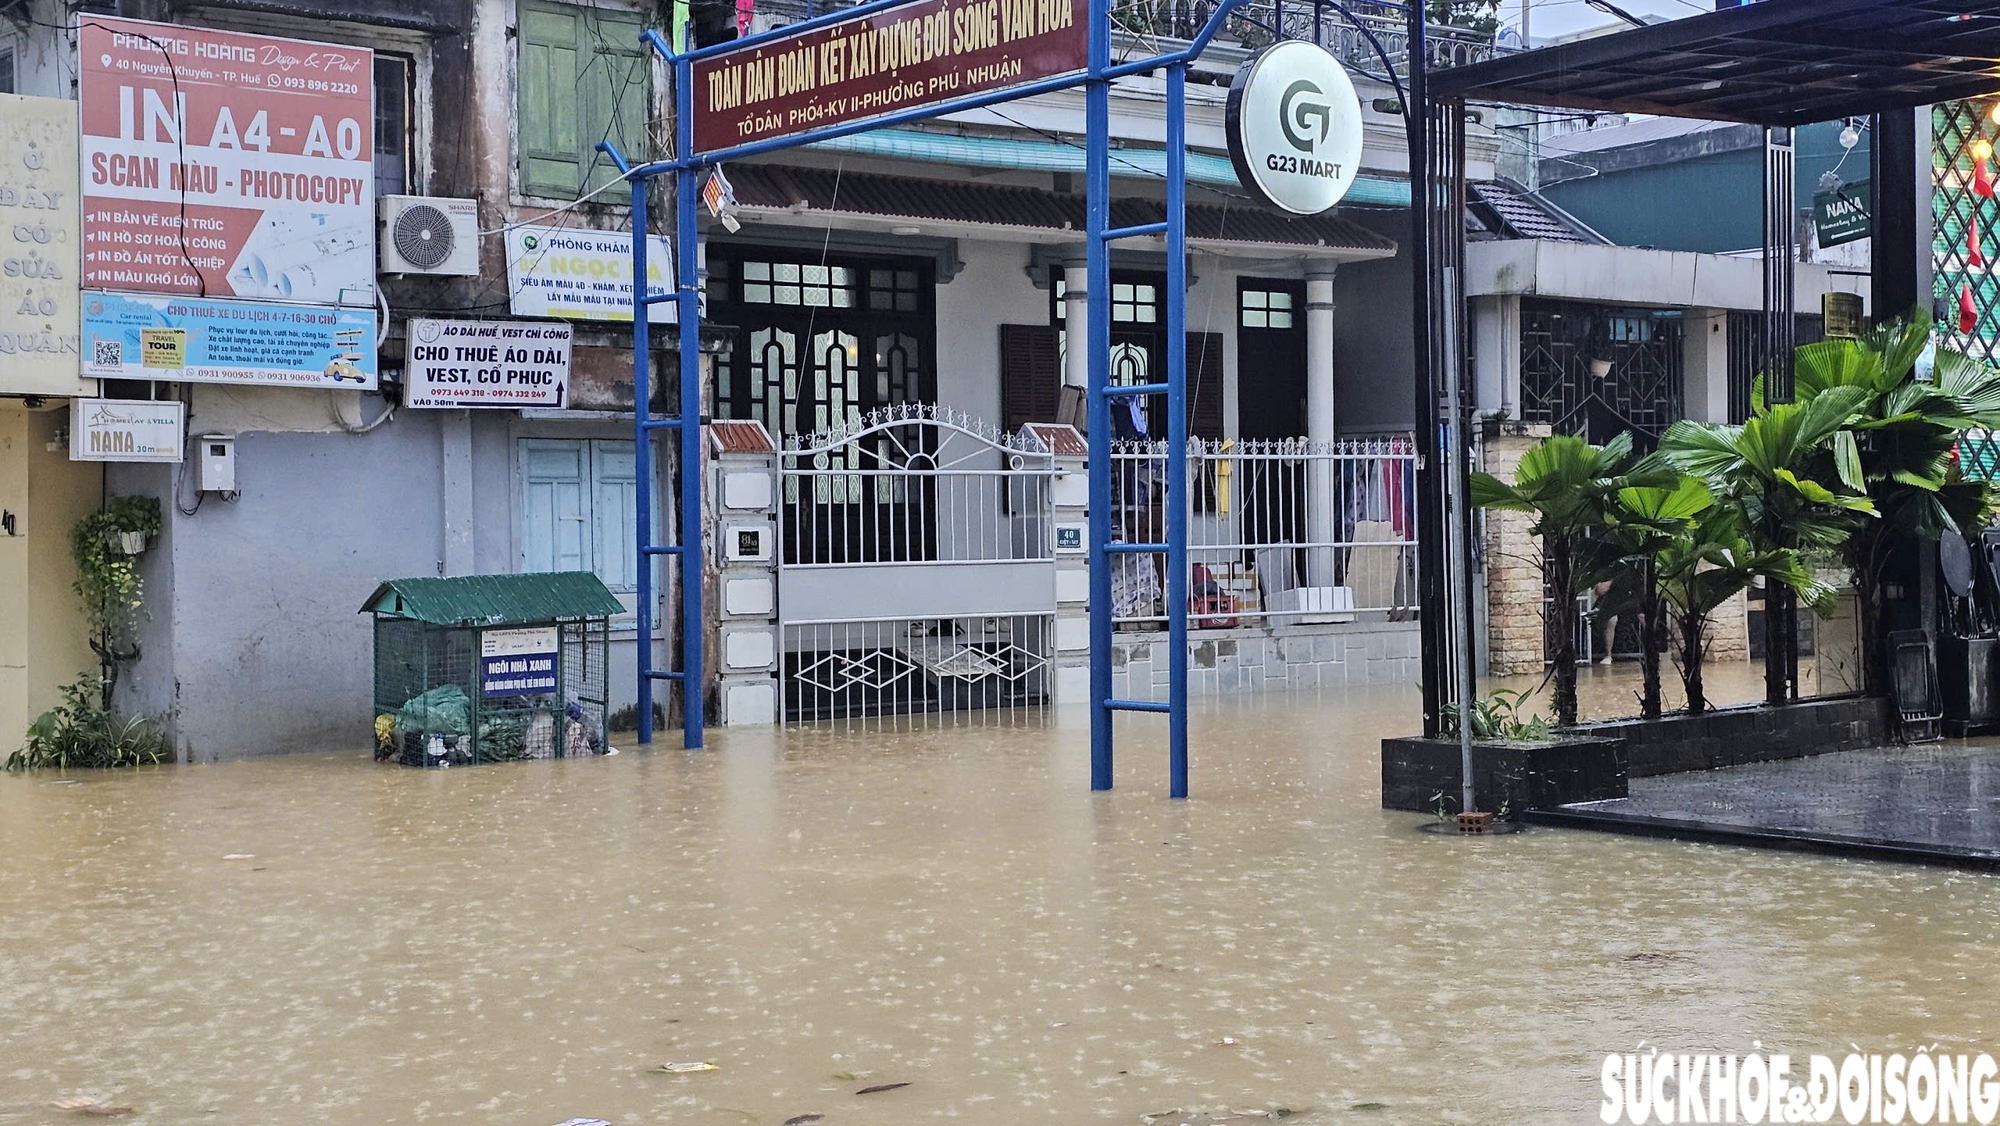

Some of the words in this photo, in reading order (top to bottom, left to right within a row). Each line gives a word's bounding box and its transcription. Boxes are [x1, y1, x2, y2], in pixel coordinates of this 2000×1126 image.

[195, 42, 255, 62] HOÀNG
[304, 53, 319, 68] &
[708, 58, 742, 112] TOÀN
[746, 50, 774, 104] DÂN
[779, 41, 815, 97] ĐOÀN
[820, 26, 846, 86] KẾT
[849, 21, 878, 79] XÂY
[880, 18, 921, 77] DỰNG
[923, 0, 950, 61] ĐỜI
[116, 59, 129, 69] 40
[175, 65, 212, 80] Khuyến
[222, 71, 237, 81] TP.
[240, 72, 261, 84] Huế
[284, 77, 305, 89] 093
[308, 79, 328, 91] 896
[331, 82, 358, 94] 2220
[737, 112, 753, 136] TỔ
[756, 110, 782, 132] DÂN
[929, 66, 959, 94] PHÚ
[967, 54, 1021, 85] NHUẬN
[120, 85, 186, 146] IN
[1266, 153, 1297, 173] G23
[1300, 158, 1342, 180] MART
[92, 152, 159, 188] SCAN
[170, 160, 218, 194] MÀU
[240, 168, 363, 206] PHOTOCOPY
[1826, 196, 1864, 218] NANA
[98, 211, 111, 222] IN
[114, 210, 139, 224] BẢN
[142, 212, 159, 226] VẼ
[161, 213, 189, 228] KIẾN
[191, 217, 224, 230] TRÚC
[98, 231, 111, 242] IN
[114, 229, 132, 243] HỒ
[135, 234, 153, 245] SƠ
[155, 234, 189, 247] HOÀN
[192, 236, 226, 250] CÔNG
[550, 237, 592, 251] PHÒNG
[596, 242, 630, 254] KHÁM
[98, 250, 111, 261] IN
[114, 249, 132, 263] ĐỒ
[134, 251, 152, 263] ÁN
[154, 253, 179, 266] TỐT
[181, 256, 225, 270] NGHIỆP
[551, 257, 621, 280] NGỌC
[98, 270, 111, 280] IN
[114, 269, 143, 283] MÀU
[145, 271, 171, 285] KHỔ
[174, 273, 198, 286] LỚN
[521, 277, 539, 287] SIÊU
[541, 279, 553, 287] ÂM
[555, 280, 573, 288] MÀU
[575, 281, 586, 289] 4D
[547, 292, 562, 302] LẤY
[603, 297, 615, 307] TẠI
[617, 296, 633, 306] NHÀ
[168, 305, 188, 316] CHO
[190, 306, 215, 318] THUÊ
[217, 309, 230, 319] XE
[232, 310, 246, 320] DU
[249, 310, 269, 323] LỊCH
[272, 312, 316, 324] 4-7-16-30
[208, 326, 225, 335] Phục
[259, 329, 273, 337] lịch,
[301, 331, 317, 339] công
[443, 324, 459, 336] ÁO
[460, 327, 477, 337] DÀI
[543, 328, 570, 340] CÔNG
[148, 342, 176, 350] TOUR
[208, 345, 220, 353] Đặt
[243, 346, 260, 354] hoạt,
[233, 337, 251, 345] lượng
[286, 340, 309, 348] chuyên
[310, 341, 331, 349] nghiệp
[218, 354, 235, 362] toàn,
[253, 355, 266, 363] mái
[267, 355, 275, 363] và
[276, 357, 291, 365] đúng
[414, 346, 449, 361] CHO
[455, 345, 498, 362] THUÊ
[504, 346, 528, 363] ÁO
[533, 347, 566, 366] DÀI,
[198, 369, 219, 378] 0931
[221, 370, 254, 379] 900955
[290, 373, 321, 382] 906936
[426, 368, 471, 385] VEST,
[477, 363, 502, 383] CỔ
[507, 370, 553, 388] PHỤC
[454, 389, 470, 397] 649
[472, 389, 485, 397] 318
[90, 431, 134, 453] NANA
[1064, 530, 1074, 539] 40
[488, 660, 509, 674] NGÔI
[510, 658, 528, 673] NHÀ
[529, 659, 552, 672] XANH
